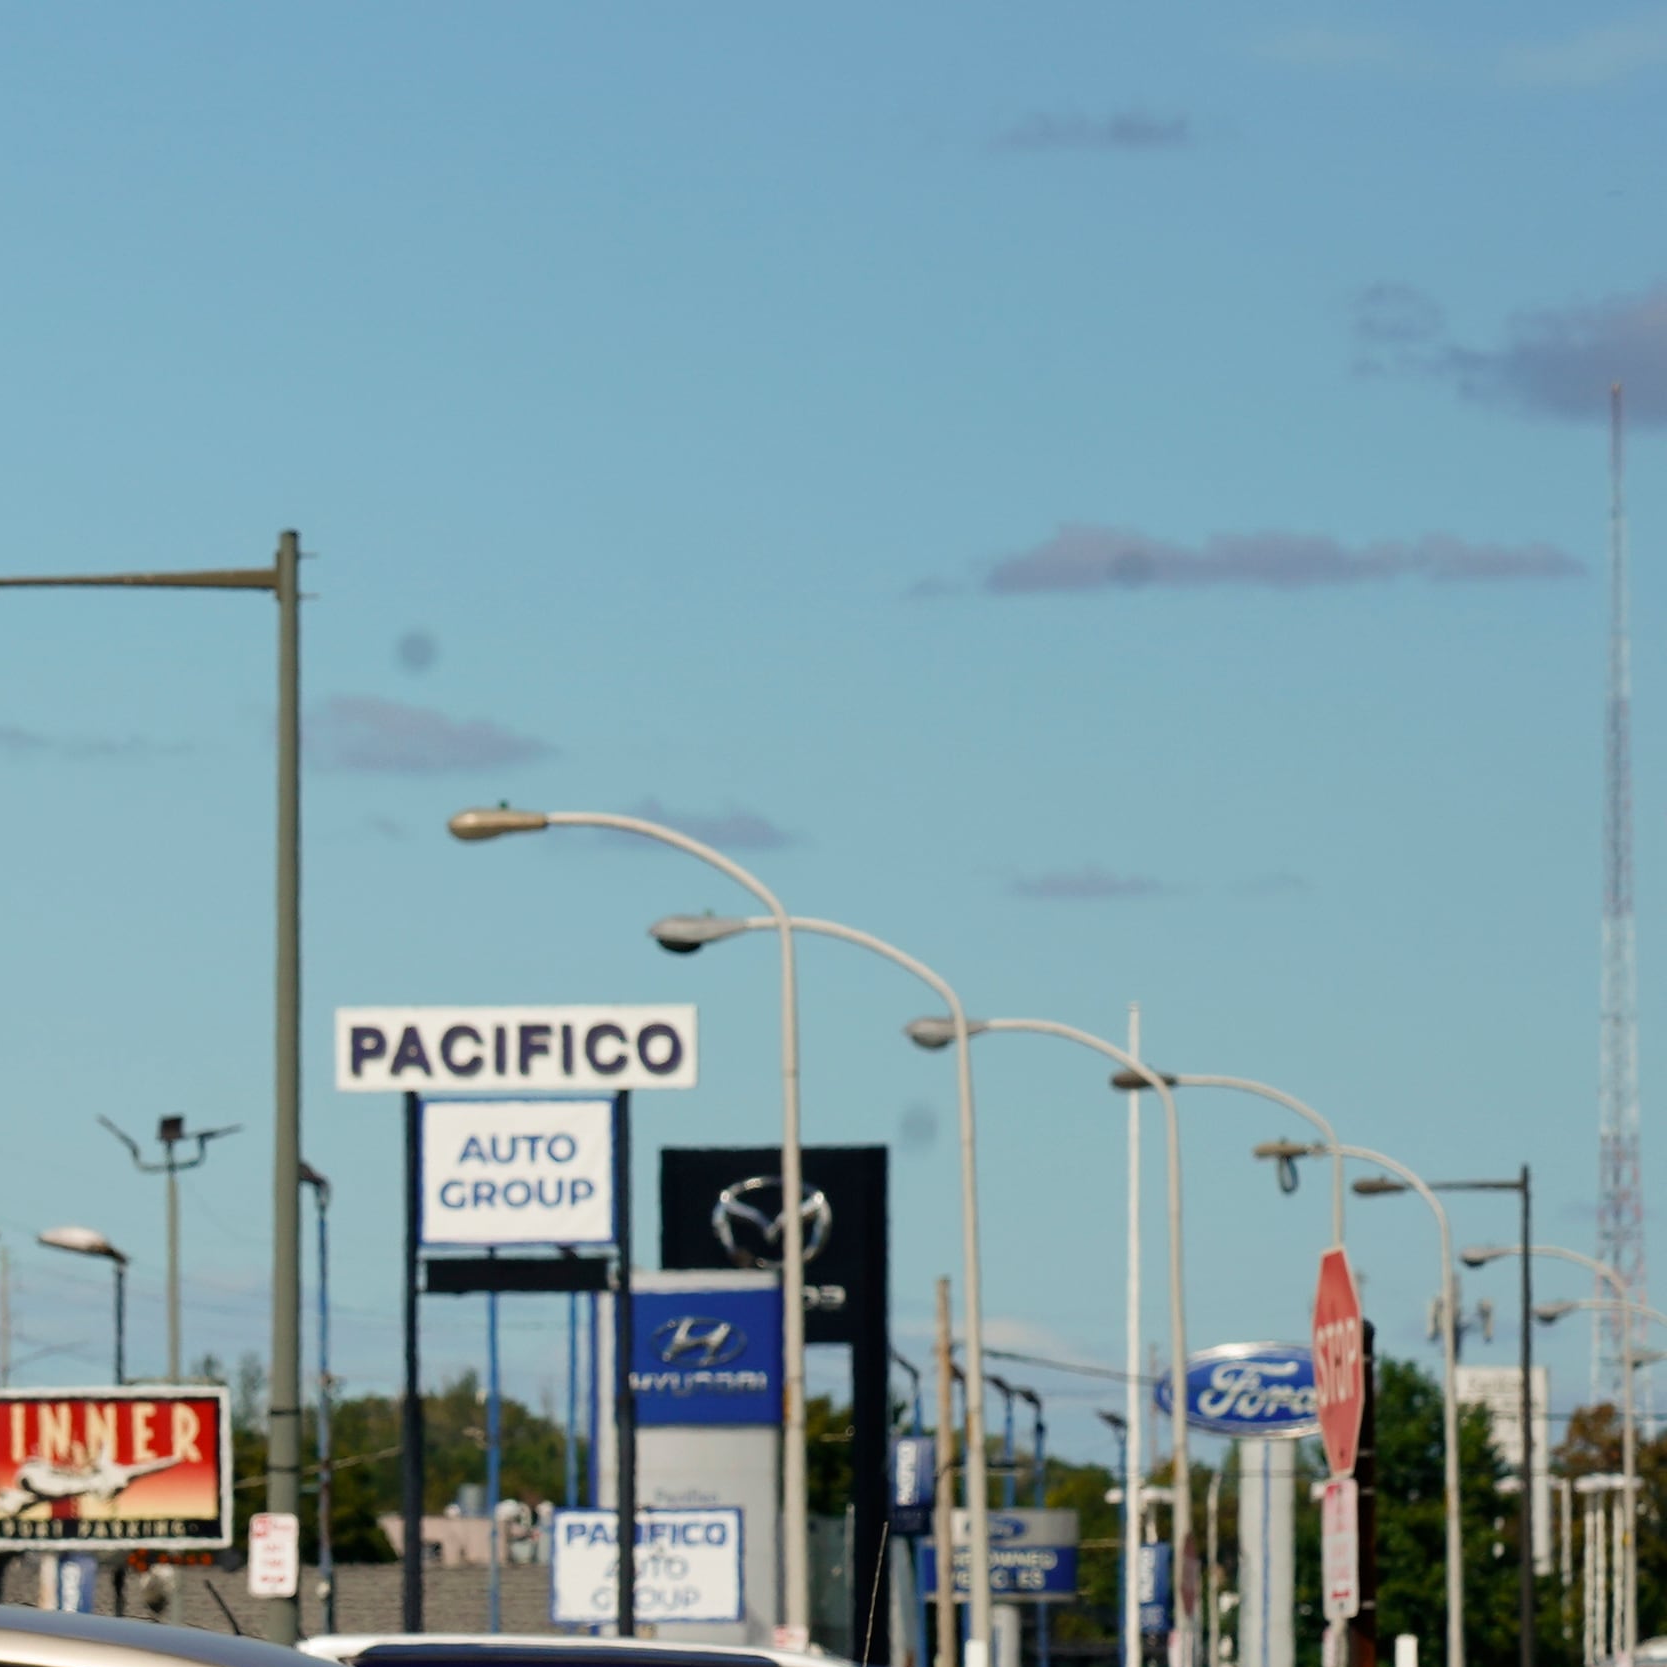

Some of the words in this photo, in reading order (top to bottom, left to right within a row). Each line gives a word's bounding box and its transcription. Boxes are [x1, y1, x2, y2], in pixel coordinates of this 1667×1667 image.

[350, 1022, 684, 1077] PACIFICO
[458, 1133, 578, 1166] AUTO
[439, 1178, 596, 1211] GROUP
[1316, 1316, 1357, 1408] STOP
[590, 1586, 700, 1610] GOUP
